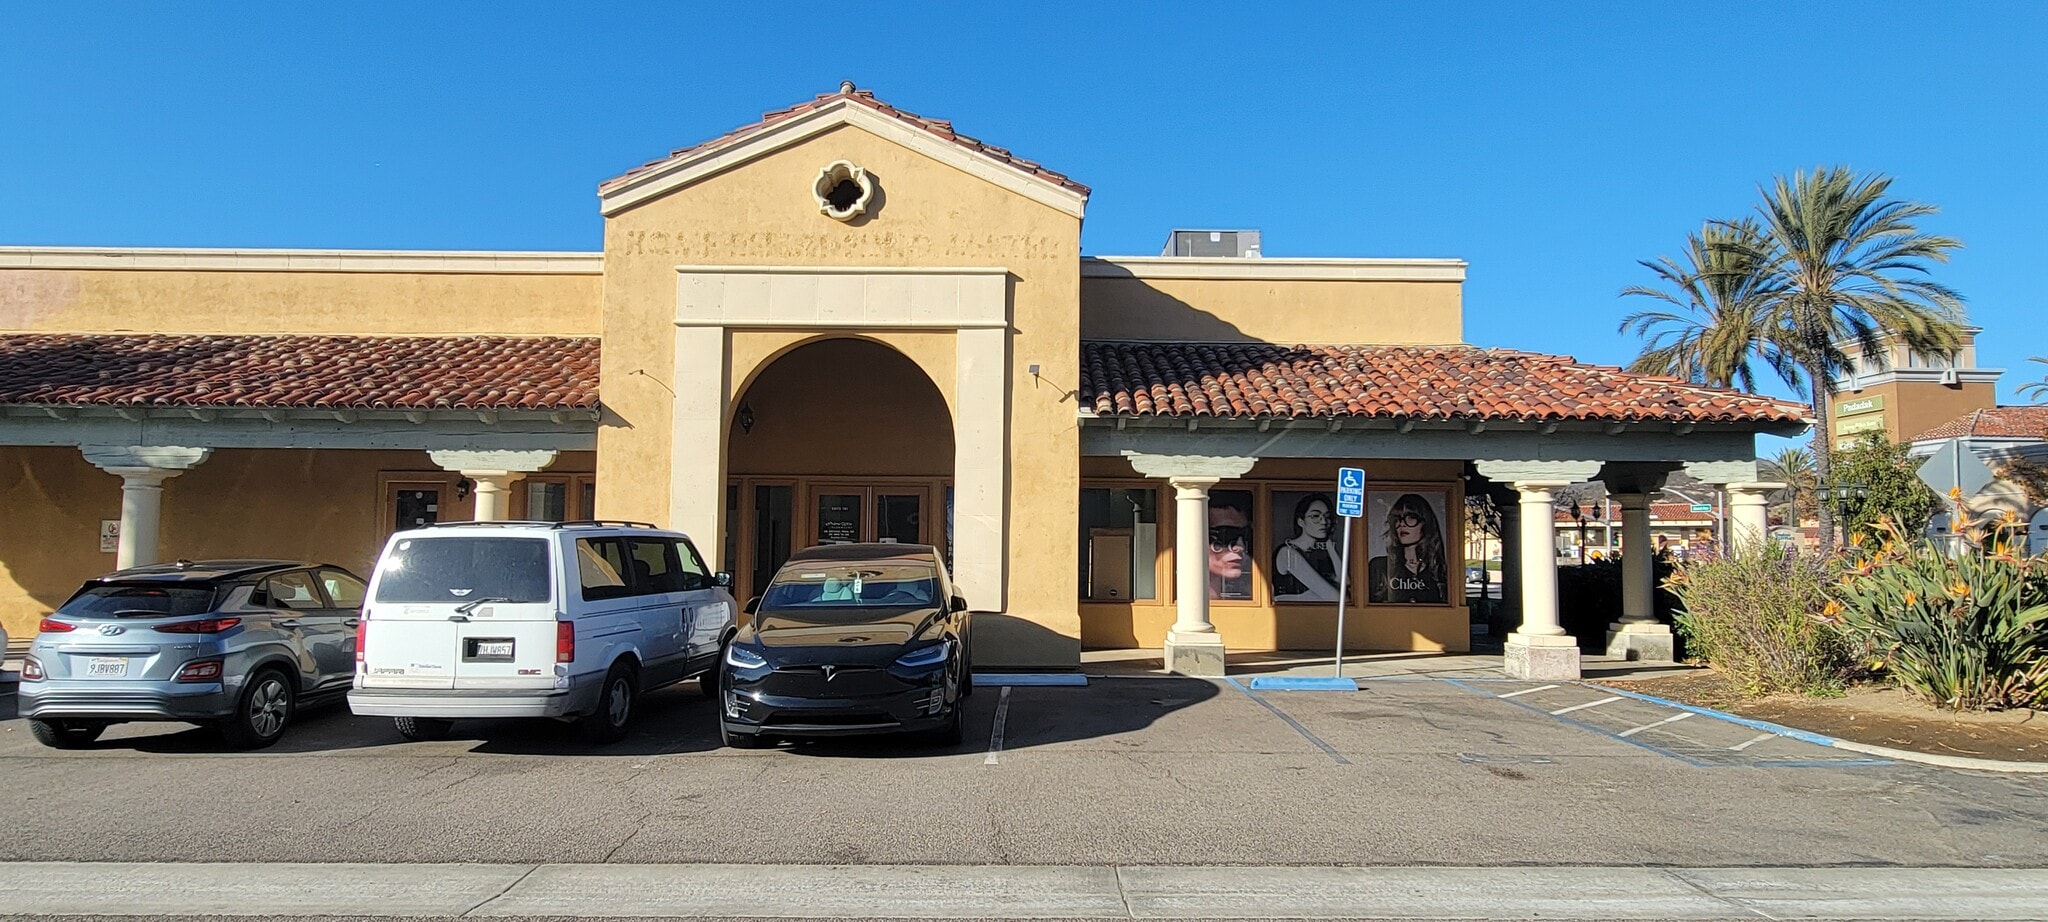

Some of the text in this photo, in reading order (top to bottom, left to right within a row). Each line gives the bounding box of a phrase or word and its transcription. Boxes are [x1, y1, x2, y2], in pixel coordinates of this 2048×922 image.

[1843, 400, 1873, 412] Padadak
[1340, 487, 1362, 495] PARKING
[1344, 494, 1358, 502] ONLY
[1389, 577, 1425, 590] Chloé
